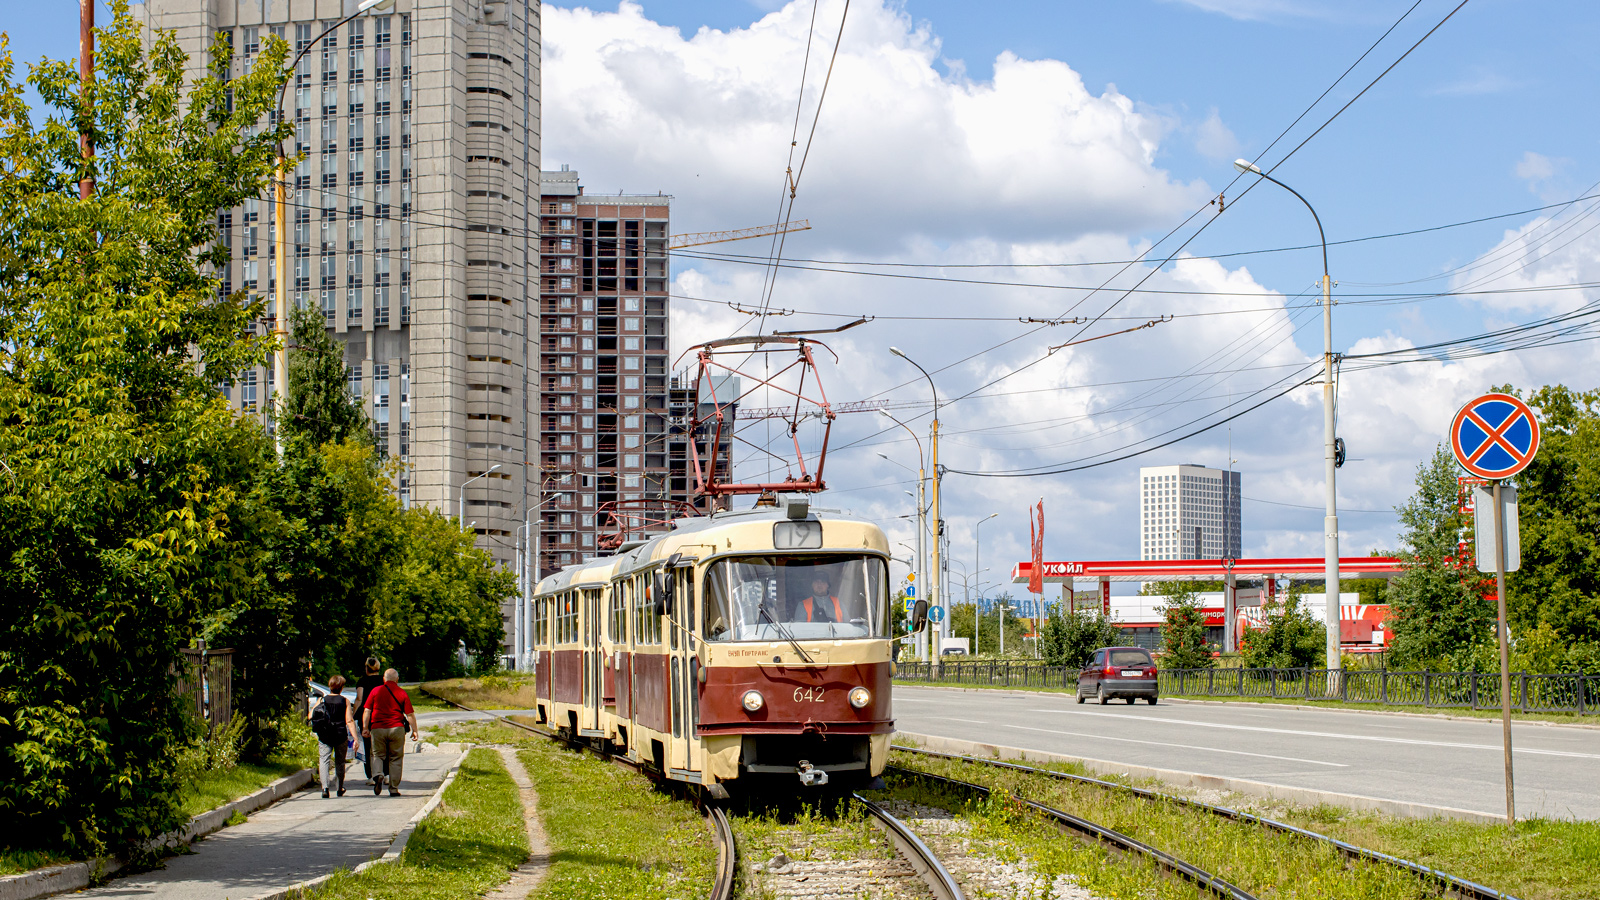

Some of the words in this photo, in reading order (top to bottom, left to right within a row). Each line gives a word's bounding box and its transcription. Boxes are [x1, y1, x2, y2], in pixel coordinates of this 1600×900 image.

[788, 523, 811, 547] 19
[1043, 562, 1083, 574] УКОЙЛ
[793, 686, 825, 703] 642
